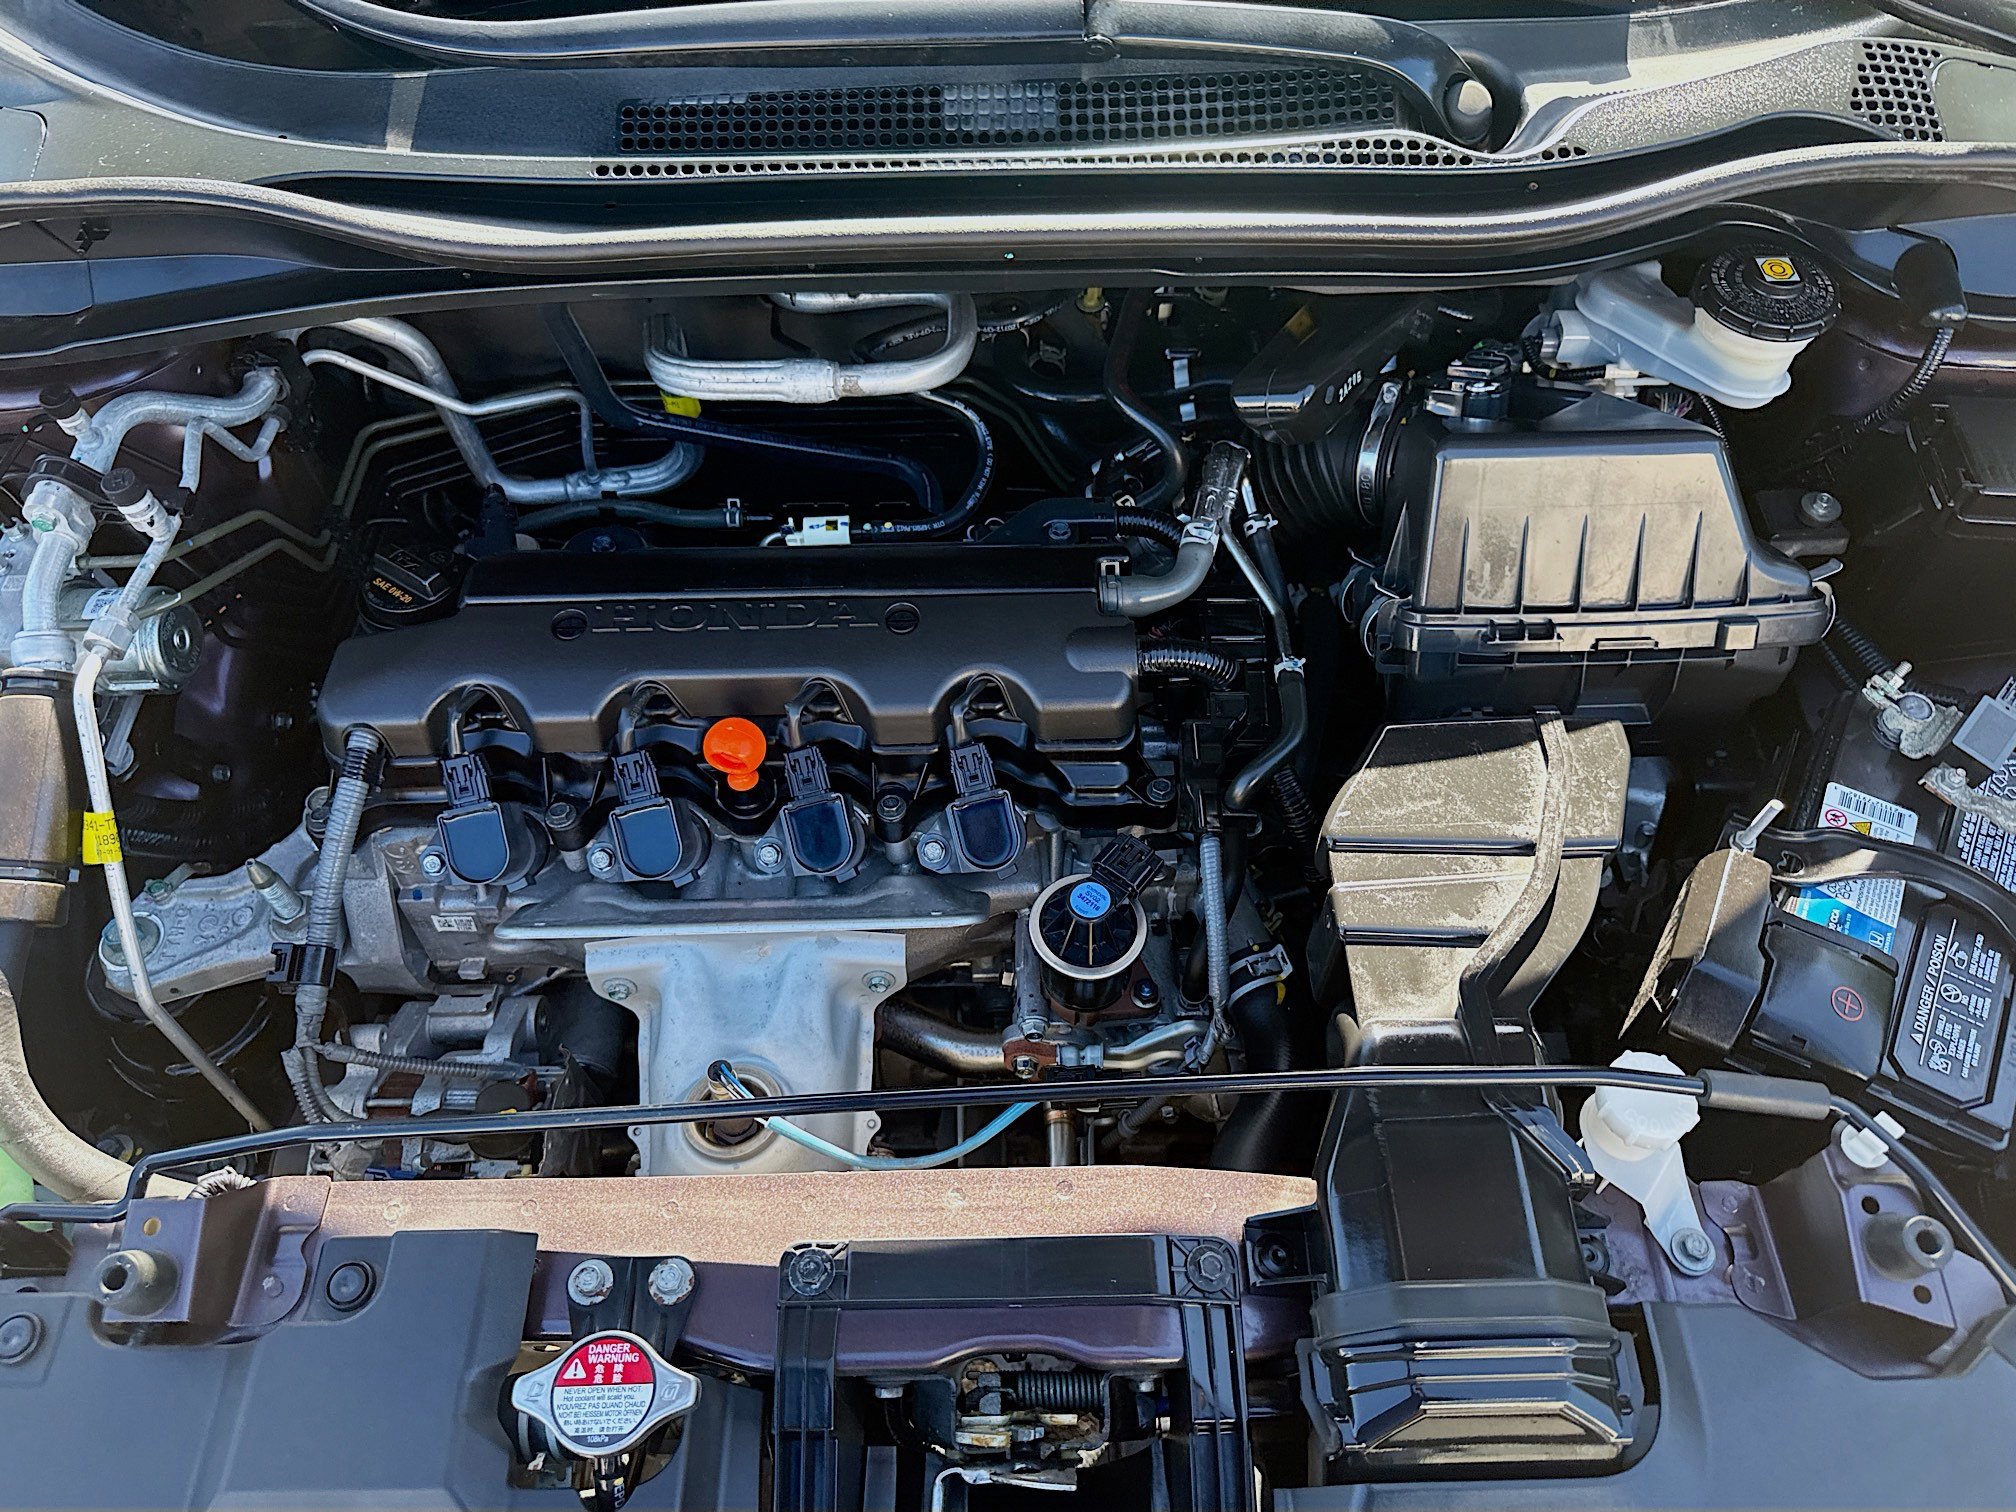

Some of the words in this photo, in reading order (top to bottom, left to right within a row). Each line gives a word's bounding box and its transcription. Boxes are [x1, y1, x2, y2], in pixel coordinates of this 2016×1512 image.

[372, 578, 392, 590] SAE
[591, 602, 879, 632] HONDA
[1943, 1023, 1953, 1040] EYES
[1948, 1024, 1962, 1056] EXPLOSIVE
[588, 1343, 630, 1354] DANGER
[588, 1353, 639, 1364] WARNUNG
